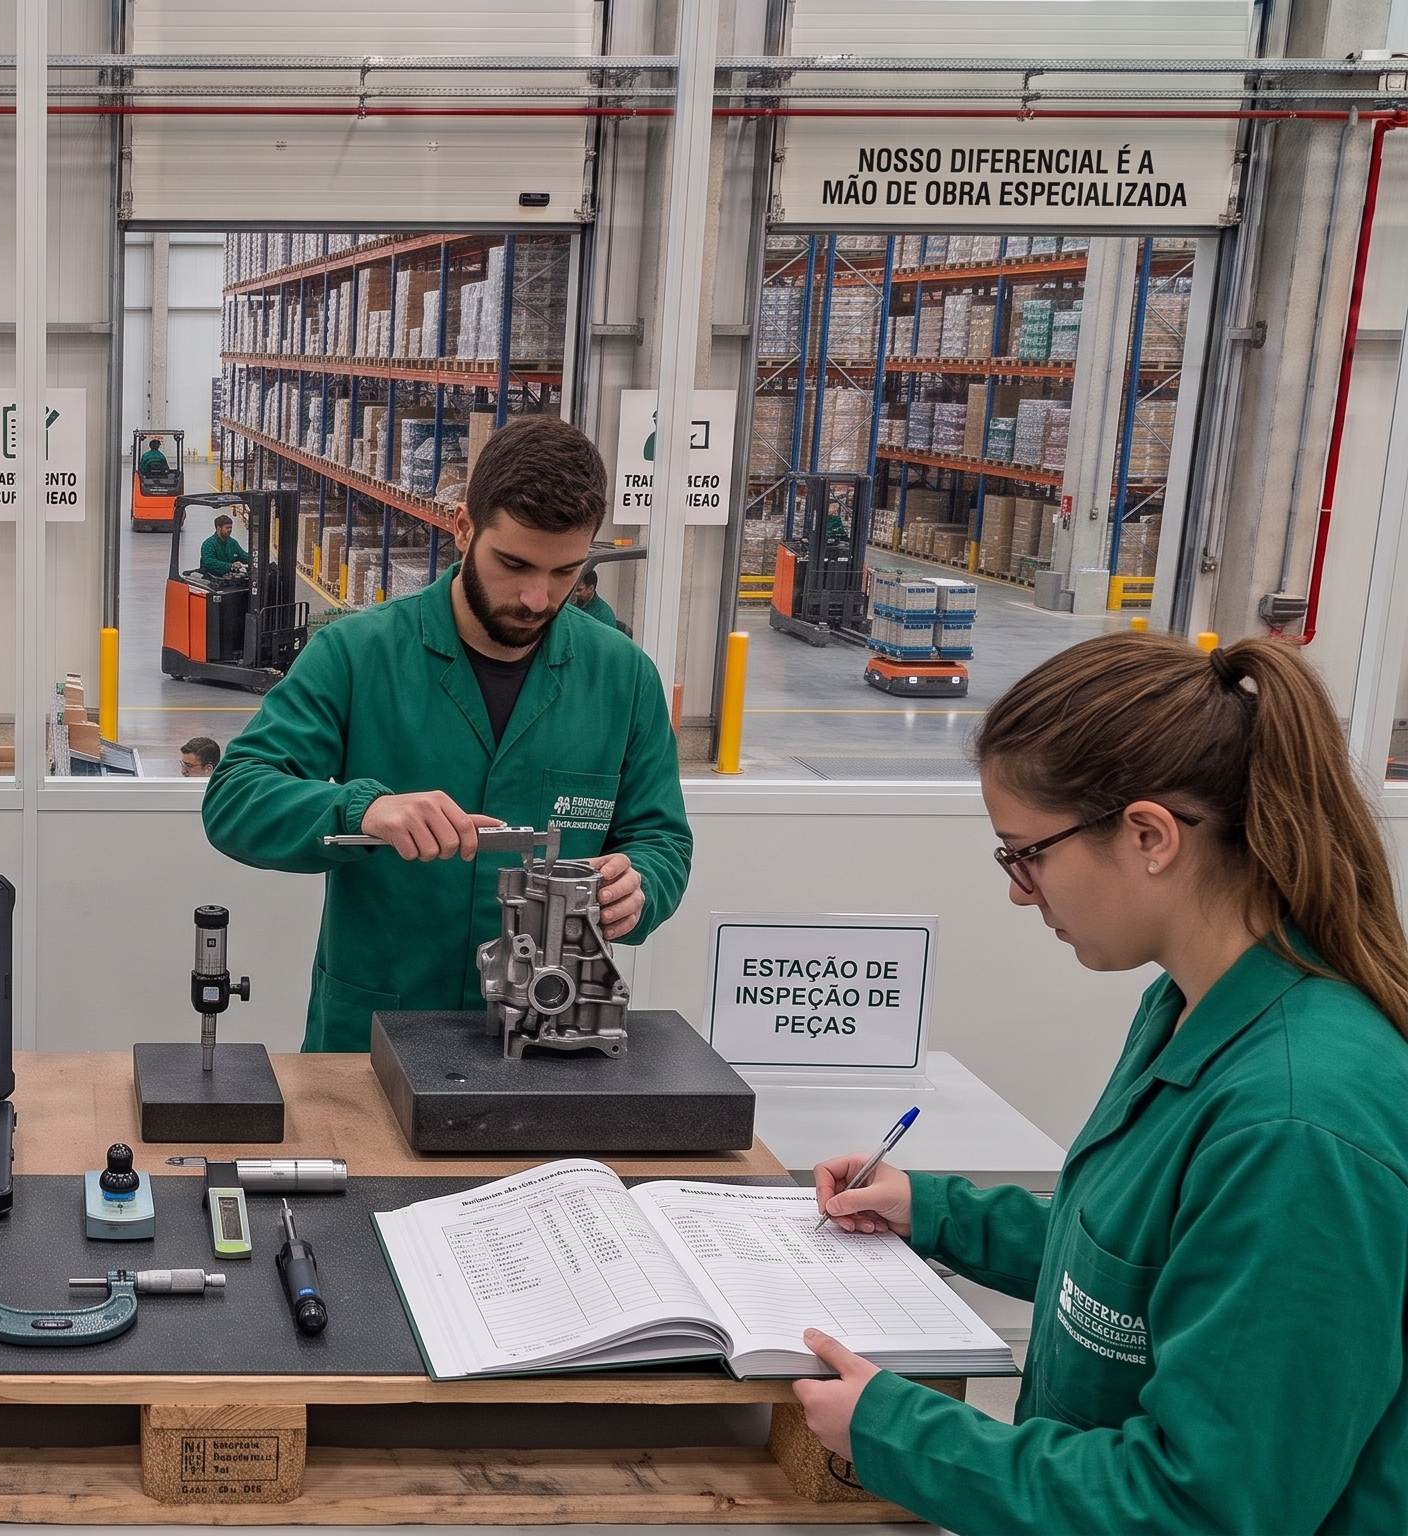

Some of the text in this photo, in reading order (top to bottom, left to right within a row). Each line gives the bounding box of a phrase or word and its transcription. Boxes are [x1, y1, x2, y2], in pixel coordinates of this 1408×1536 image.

[858, 143, 1155, 174] NOSSO DIFERENCIAL É A
[822, 174, 1188, 207] MÃO DE OBRA ESPECIALIZADA
[742, 956, 898, 982] ESTAÇÃO DE
[736, 984, 900, 1010] INSPEÇÃO DE
[774, 1015, 856, 1038] PEÇAS
